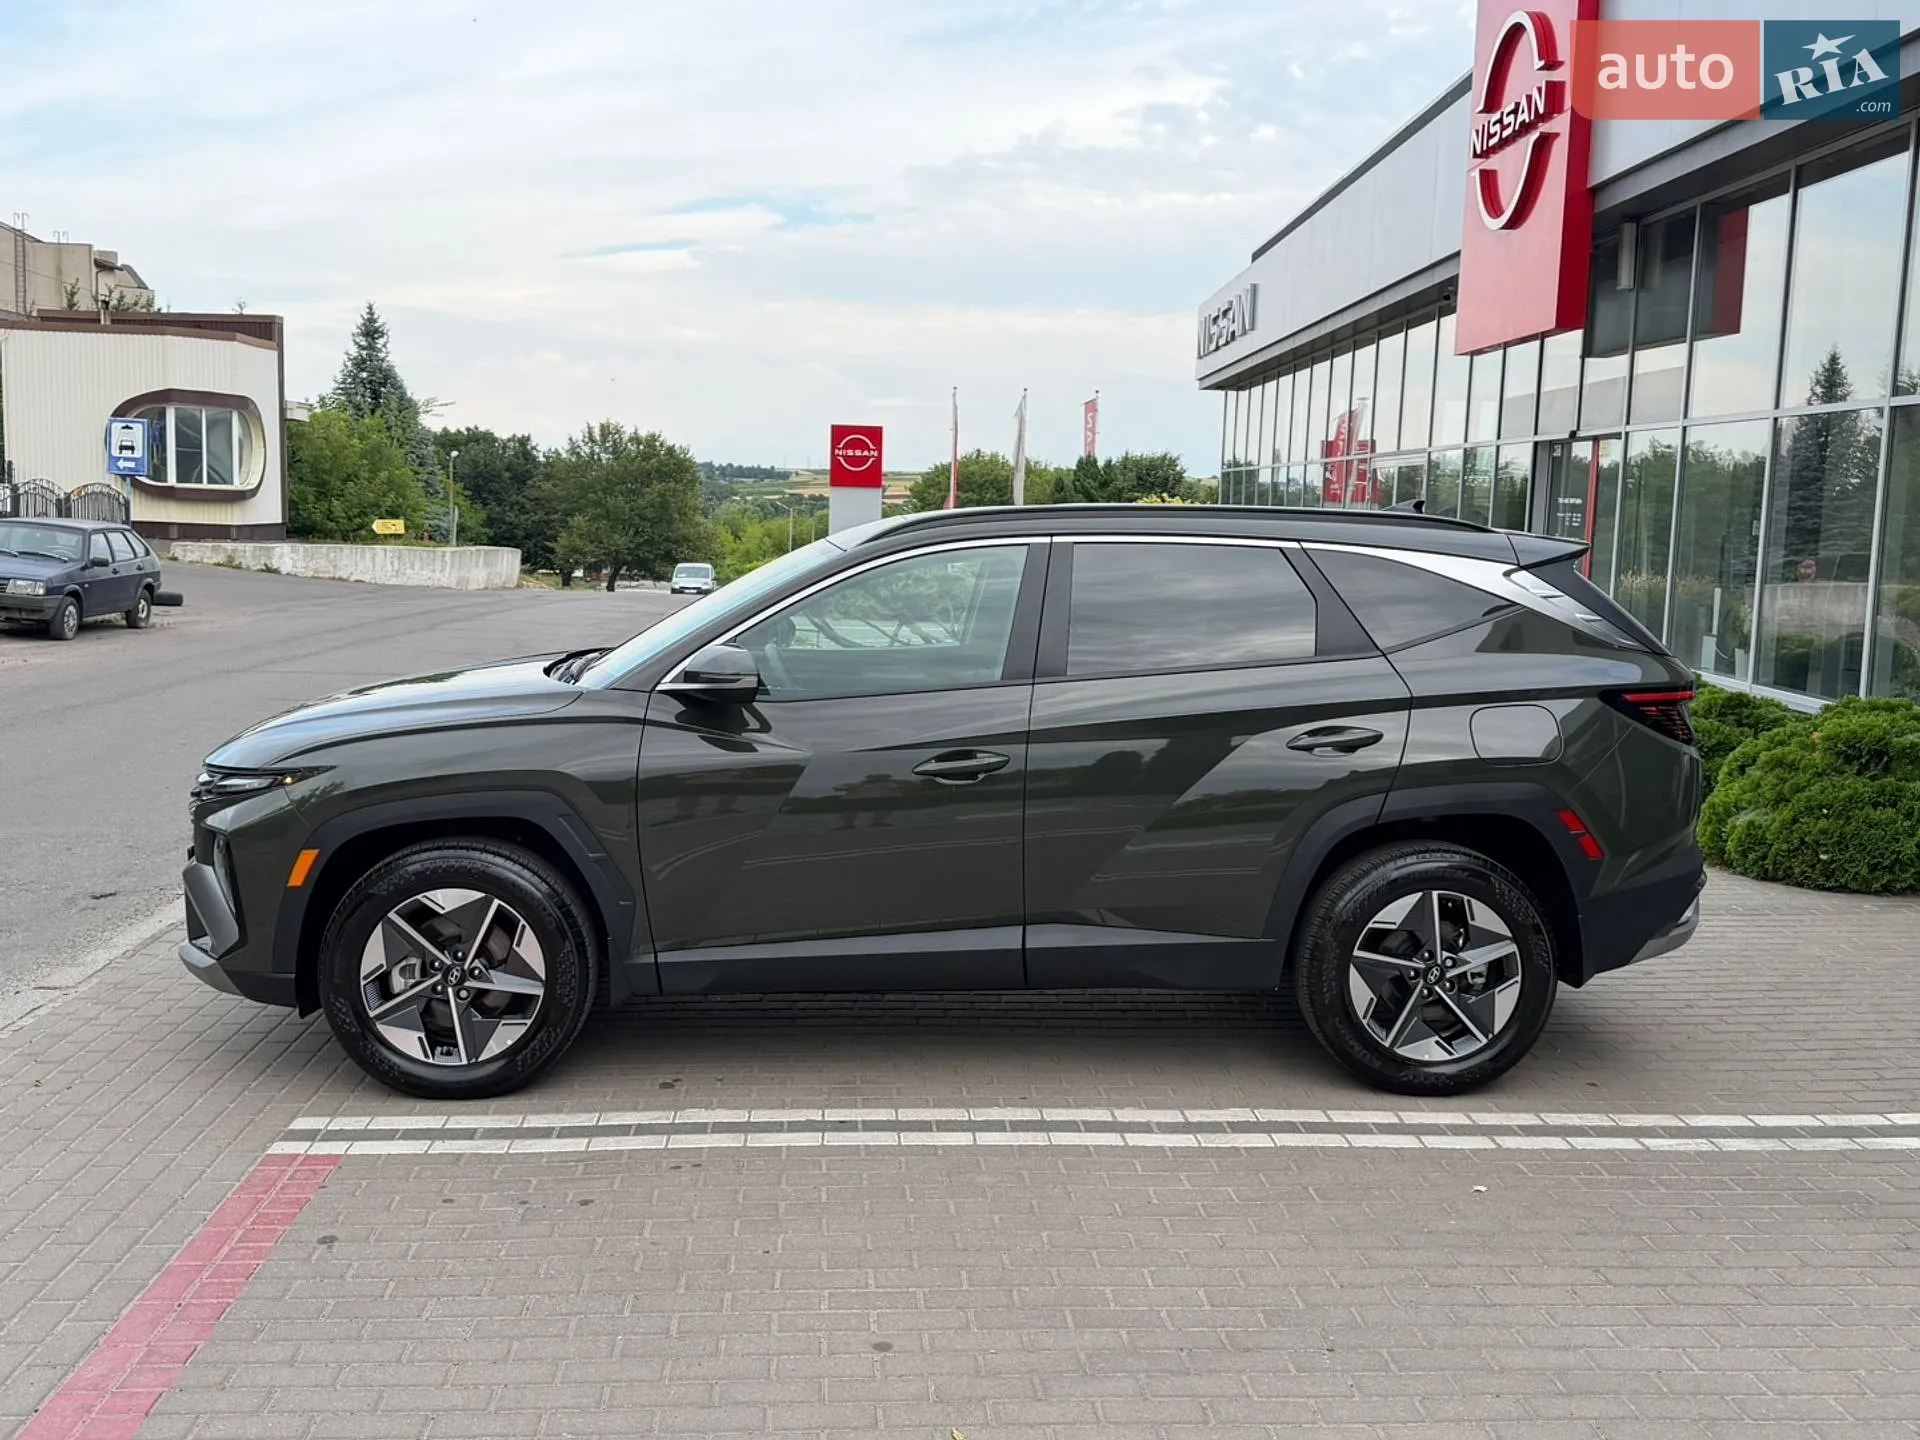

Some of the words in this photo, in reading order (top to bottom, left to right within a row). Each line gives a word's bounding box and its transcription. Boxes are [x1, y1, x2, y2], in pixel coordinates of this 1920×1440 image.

[1470, 79, 1549, 159] NISSAN
[1197, 283, 1258, 359] NISSAN
[834, 448, 878, 457] NISSAN
